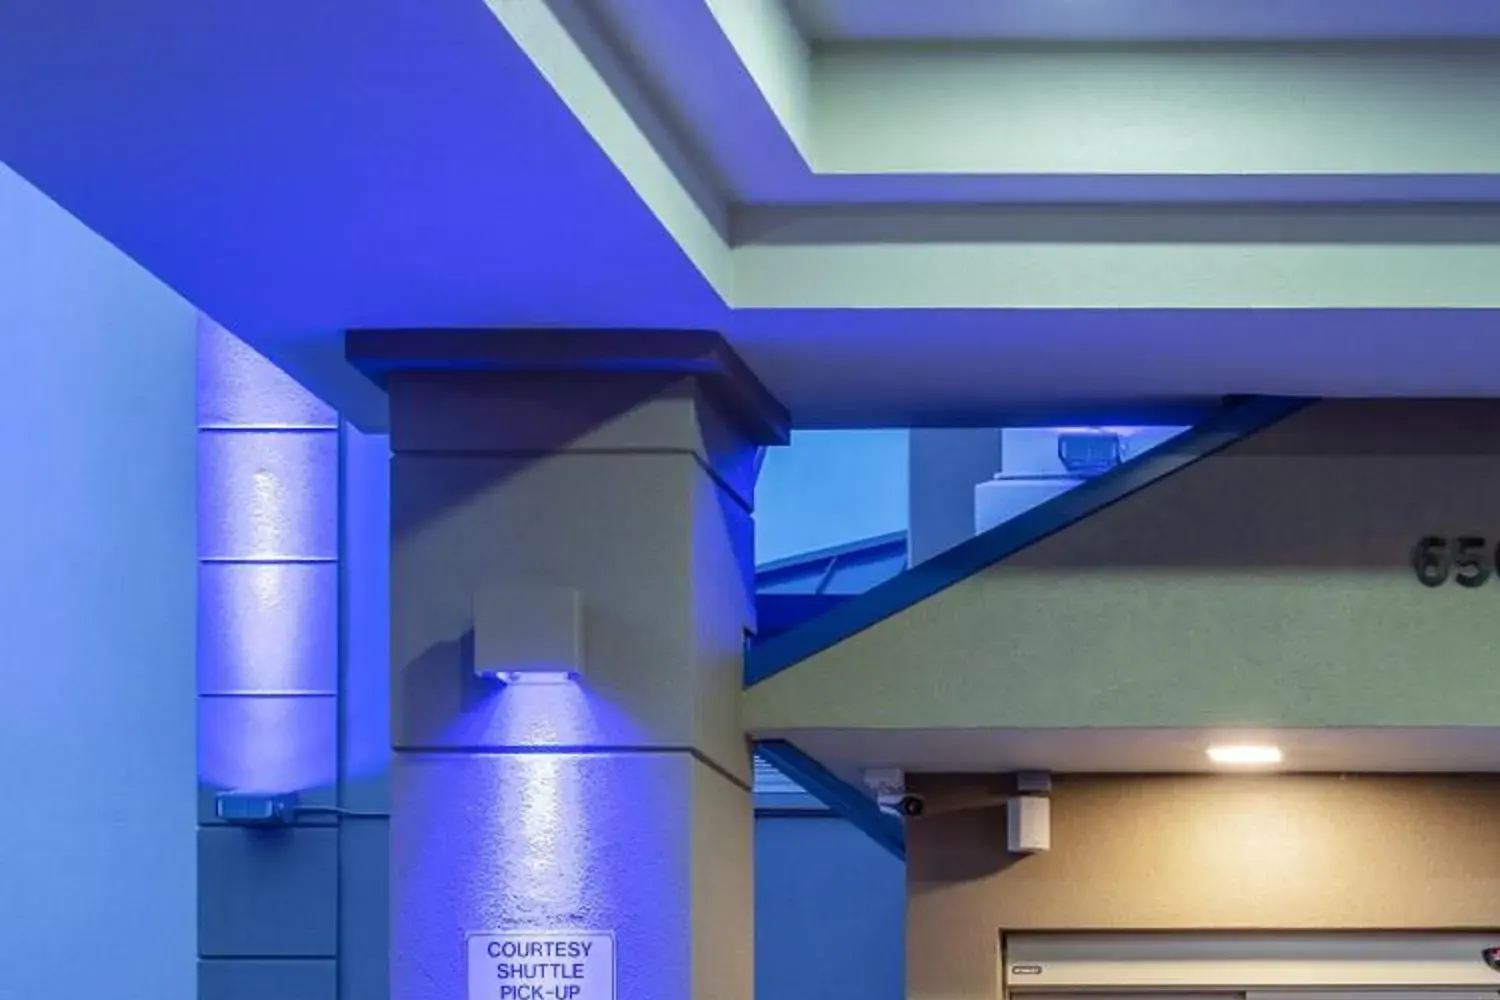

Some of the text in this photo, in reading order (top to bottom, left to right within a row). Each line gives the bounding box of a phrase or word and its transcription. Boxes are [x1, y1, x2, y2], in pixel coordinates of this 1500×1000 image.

[487, 941, 593, 958] COURTESY
[497, 963, 584, 979] SHUTTLE
[500, 985, 580, 1000] PICK-UP
